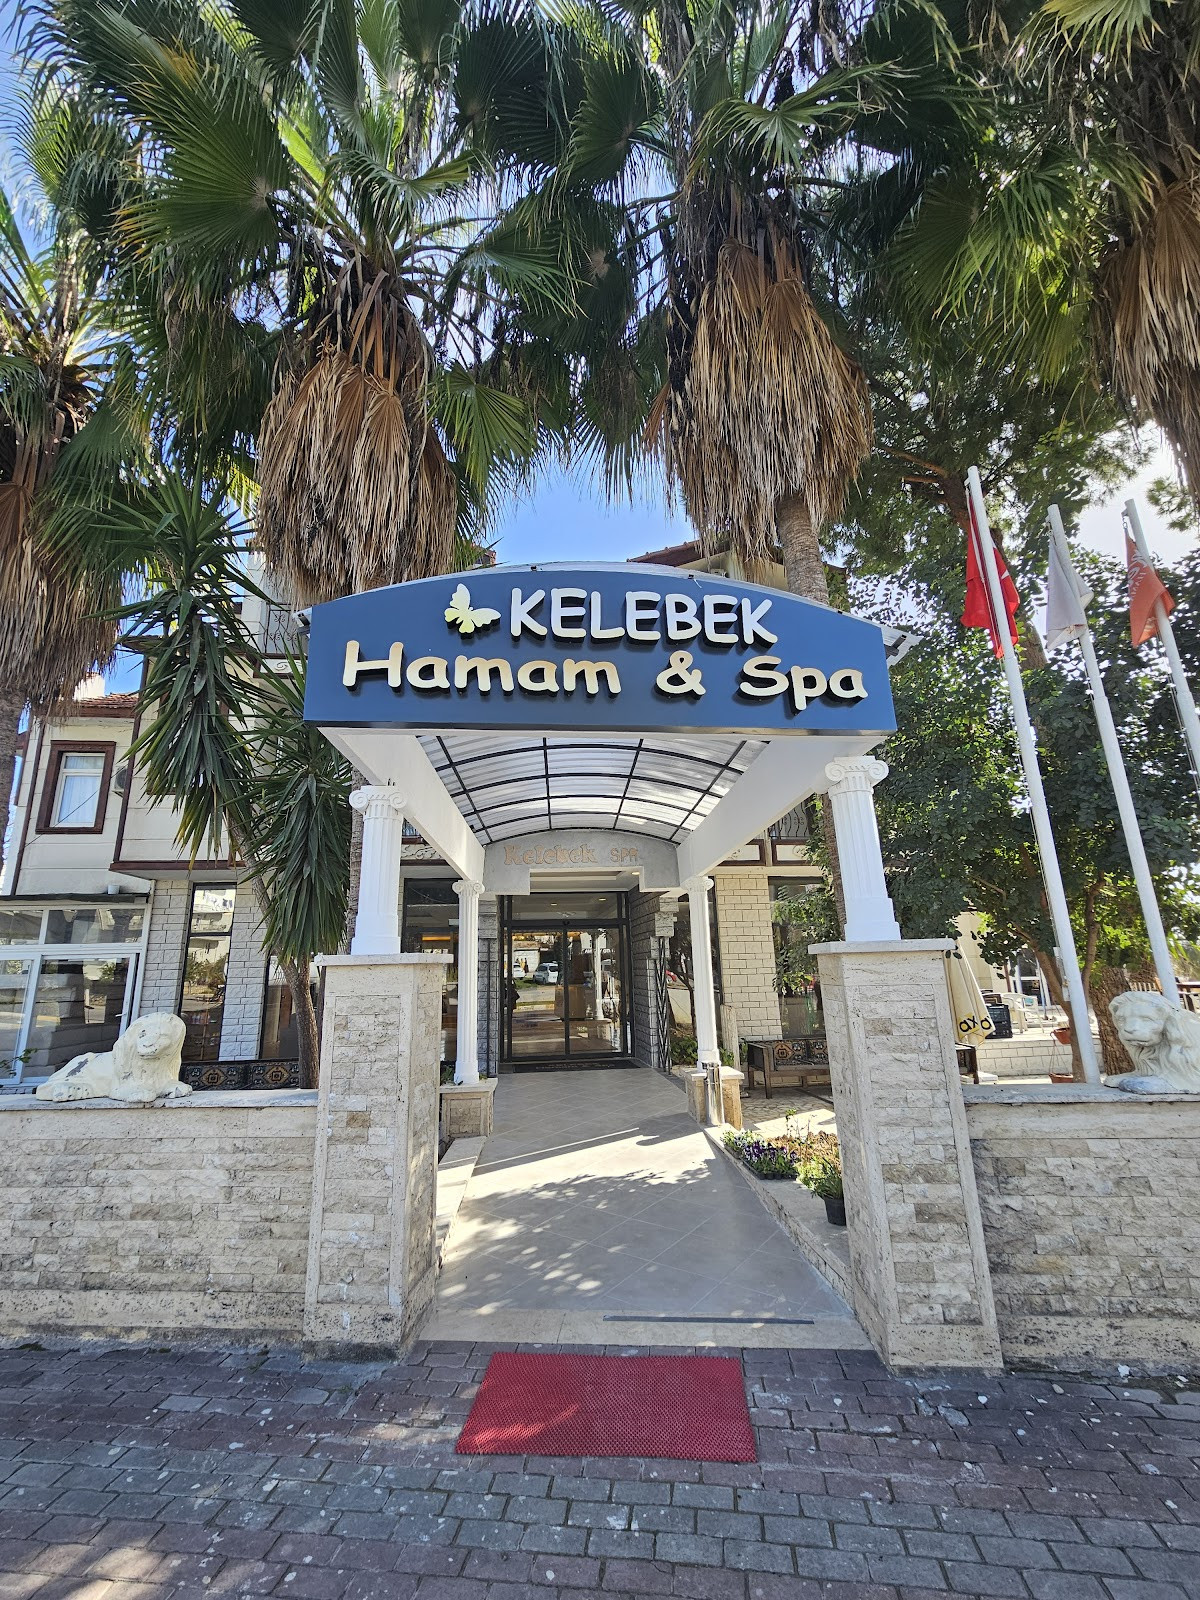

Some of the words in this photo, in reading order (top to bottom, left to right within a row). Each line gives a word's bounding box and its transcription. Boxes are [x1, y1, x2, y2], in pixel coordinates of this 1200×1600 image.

[509, 587, 779, 647] KELEBEK
[342, 639, 623, 696] Hamam
[655, 650, 707, 698] &
[739, 655, 869, 713] Spa
[503, 844, 598, 866] Kelebek
[610, 847, 639, 863] SPA
